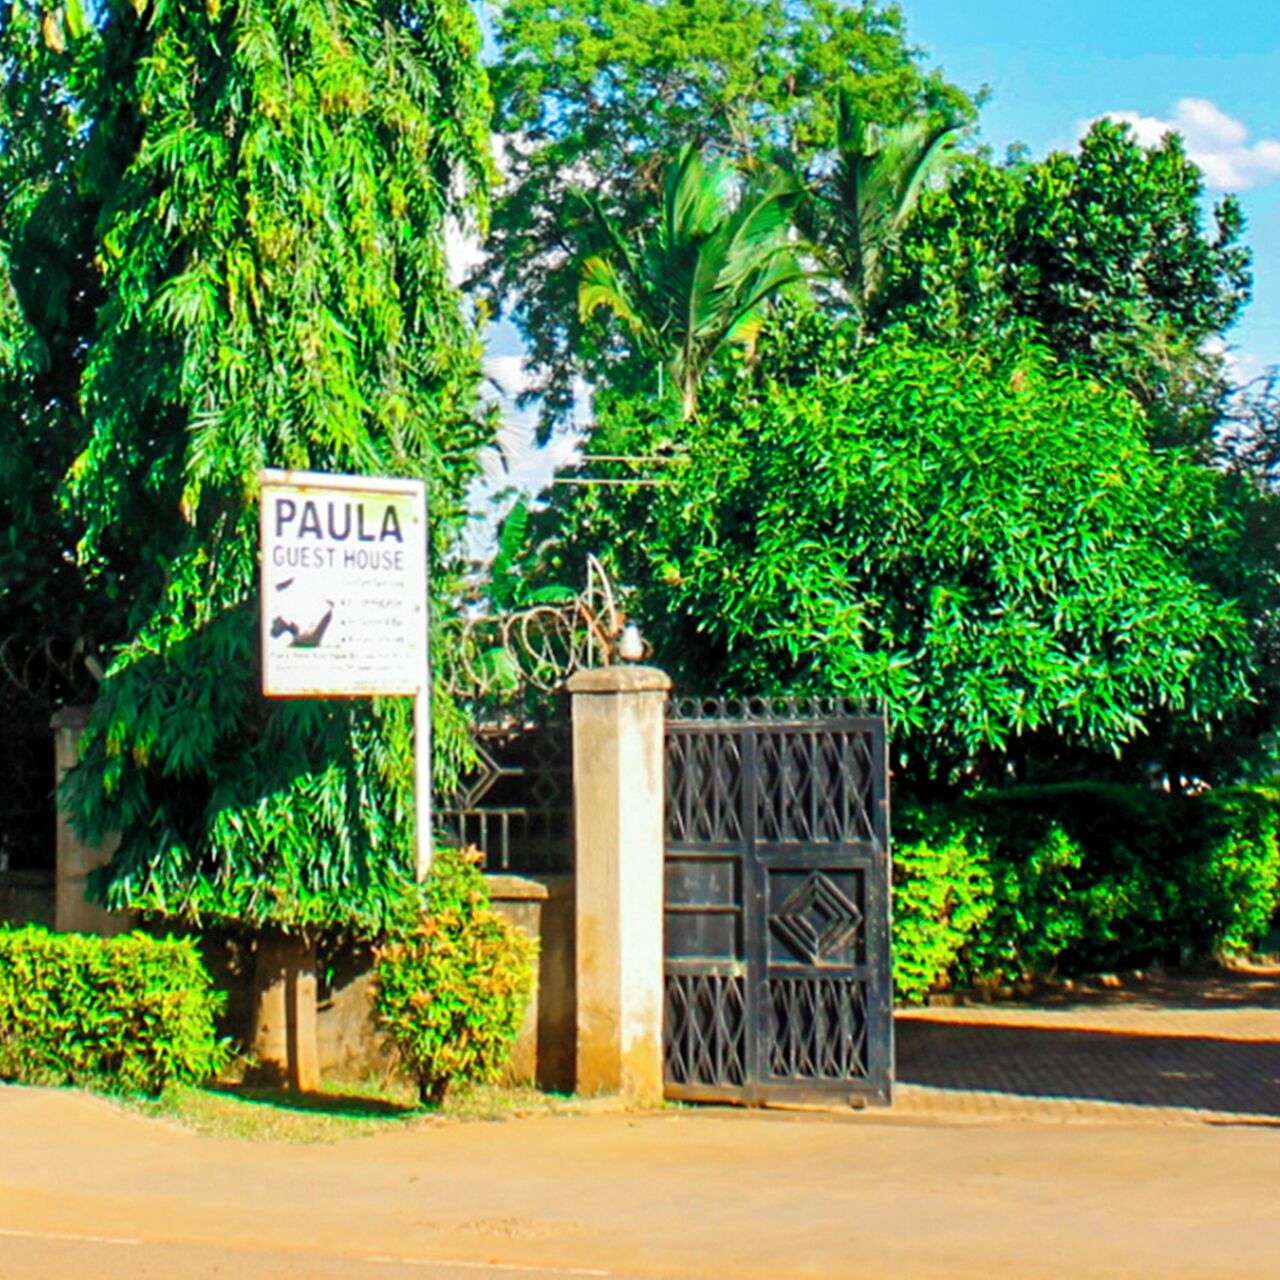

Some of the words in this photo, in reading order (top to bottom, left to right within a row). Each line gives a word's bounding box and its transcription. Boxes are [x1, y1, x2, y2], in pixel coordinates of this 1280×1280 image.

[274, 498, 404, 543] PAULA
[272, 545, 337, 568] GUEST
[344, 548, 404, 571] HOUSE
